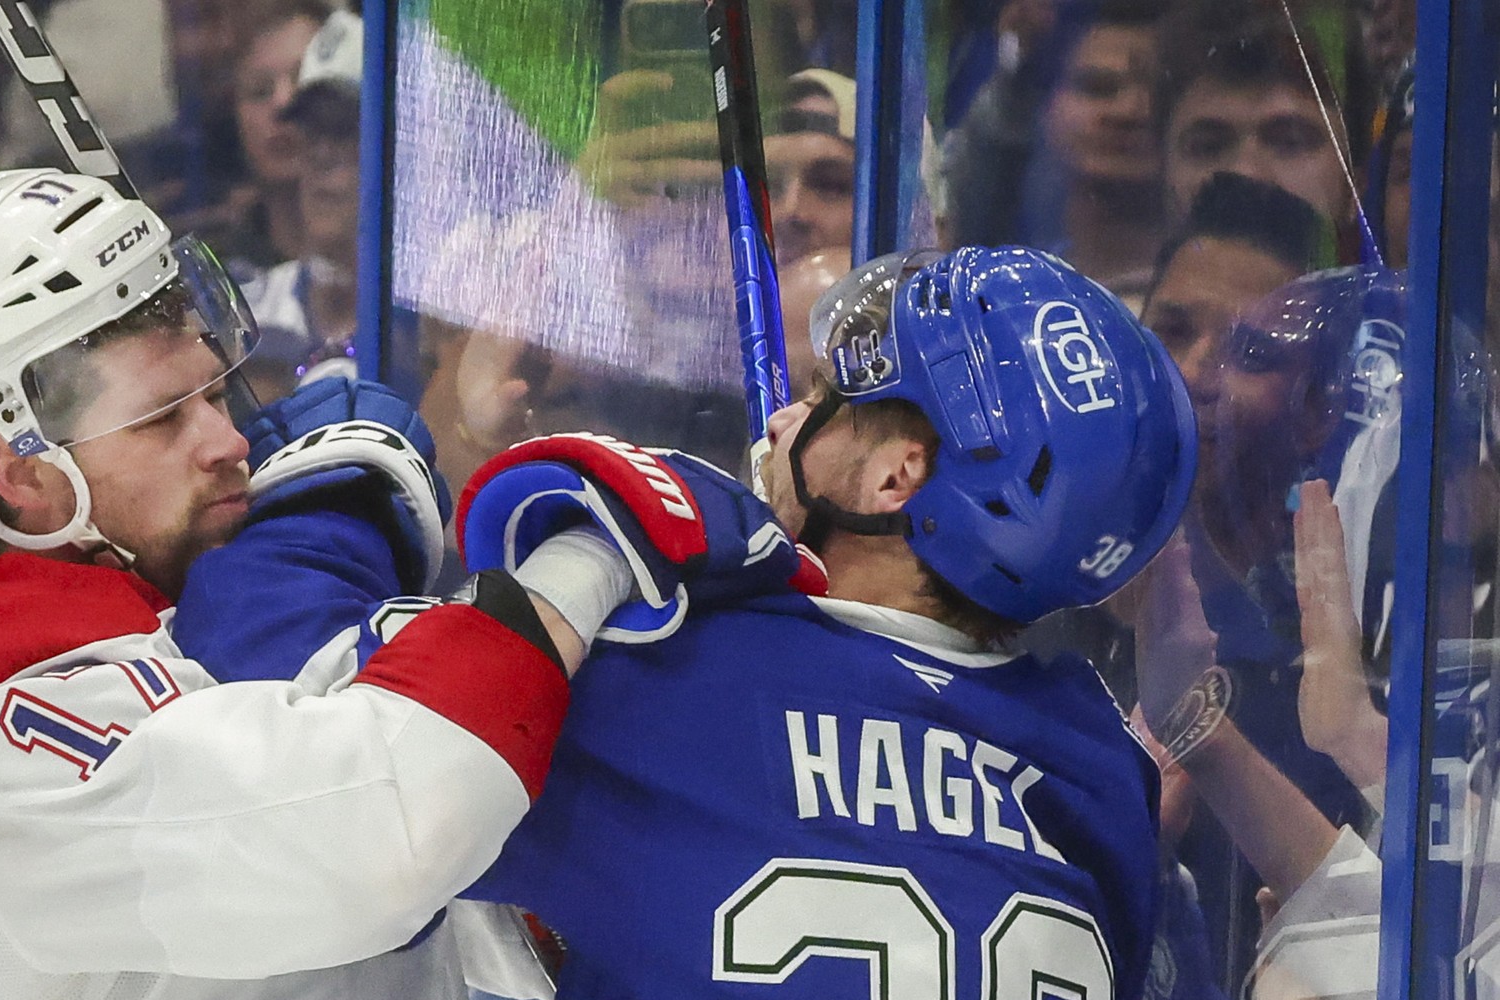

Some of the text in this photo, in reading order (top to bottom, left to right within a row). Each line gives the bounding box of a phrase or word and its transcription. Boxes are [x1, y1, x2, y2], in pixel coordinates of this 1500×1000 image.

[95, 219, 151, 268] CCM
[1046, 308, 1116, 414] TGH
[1078, 534, 1135, 580] 38
